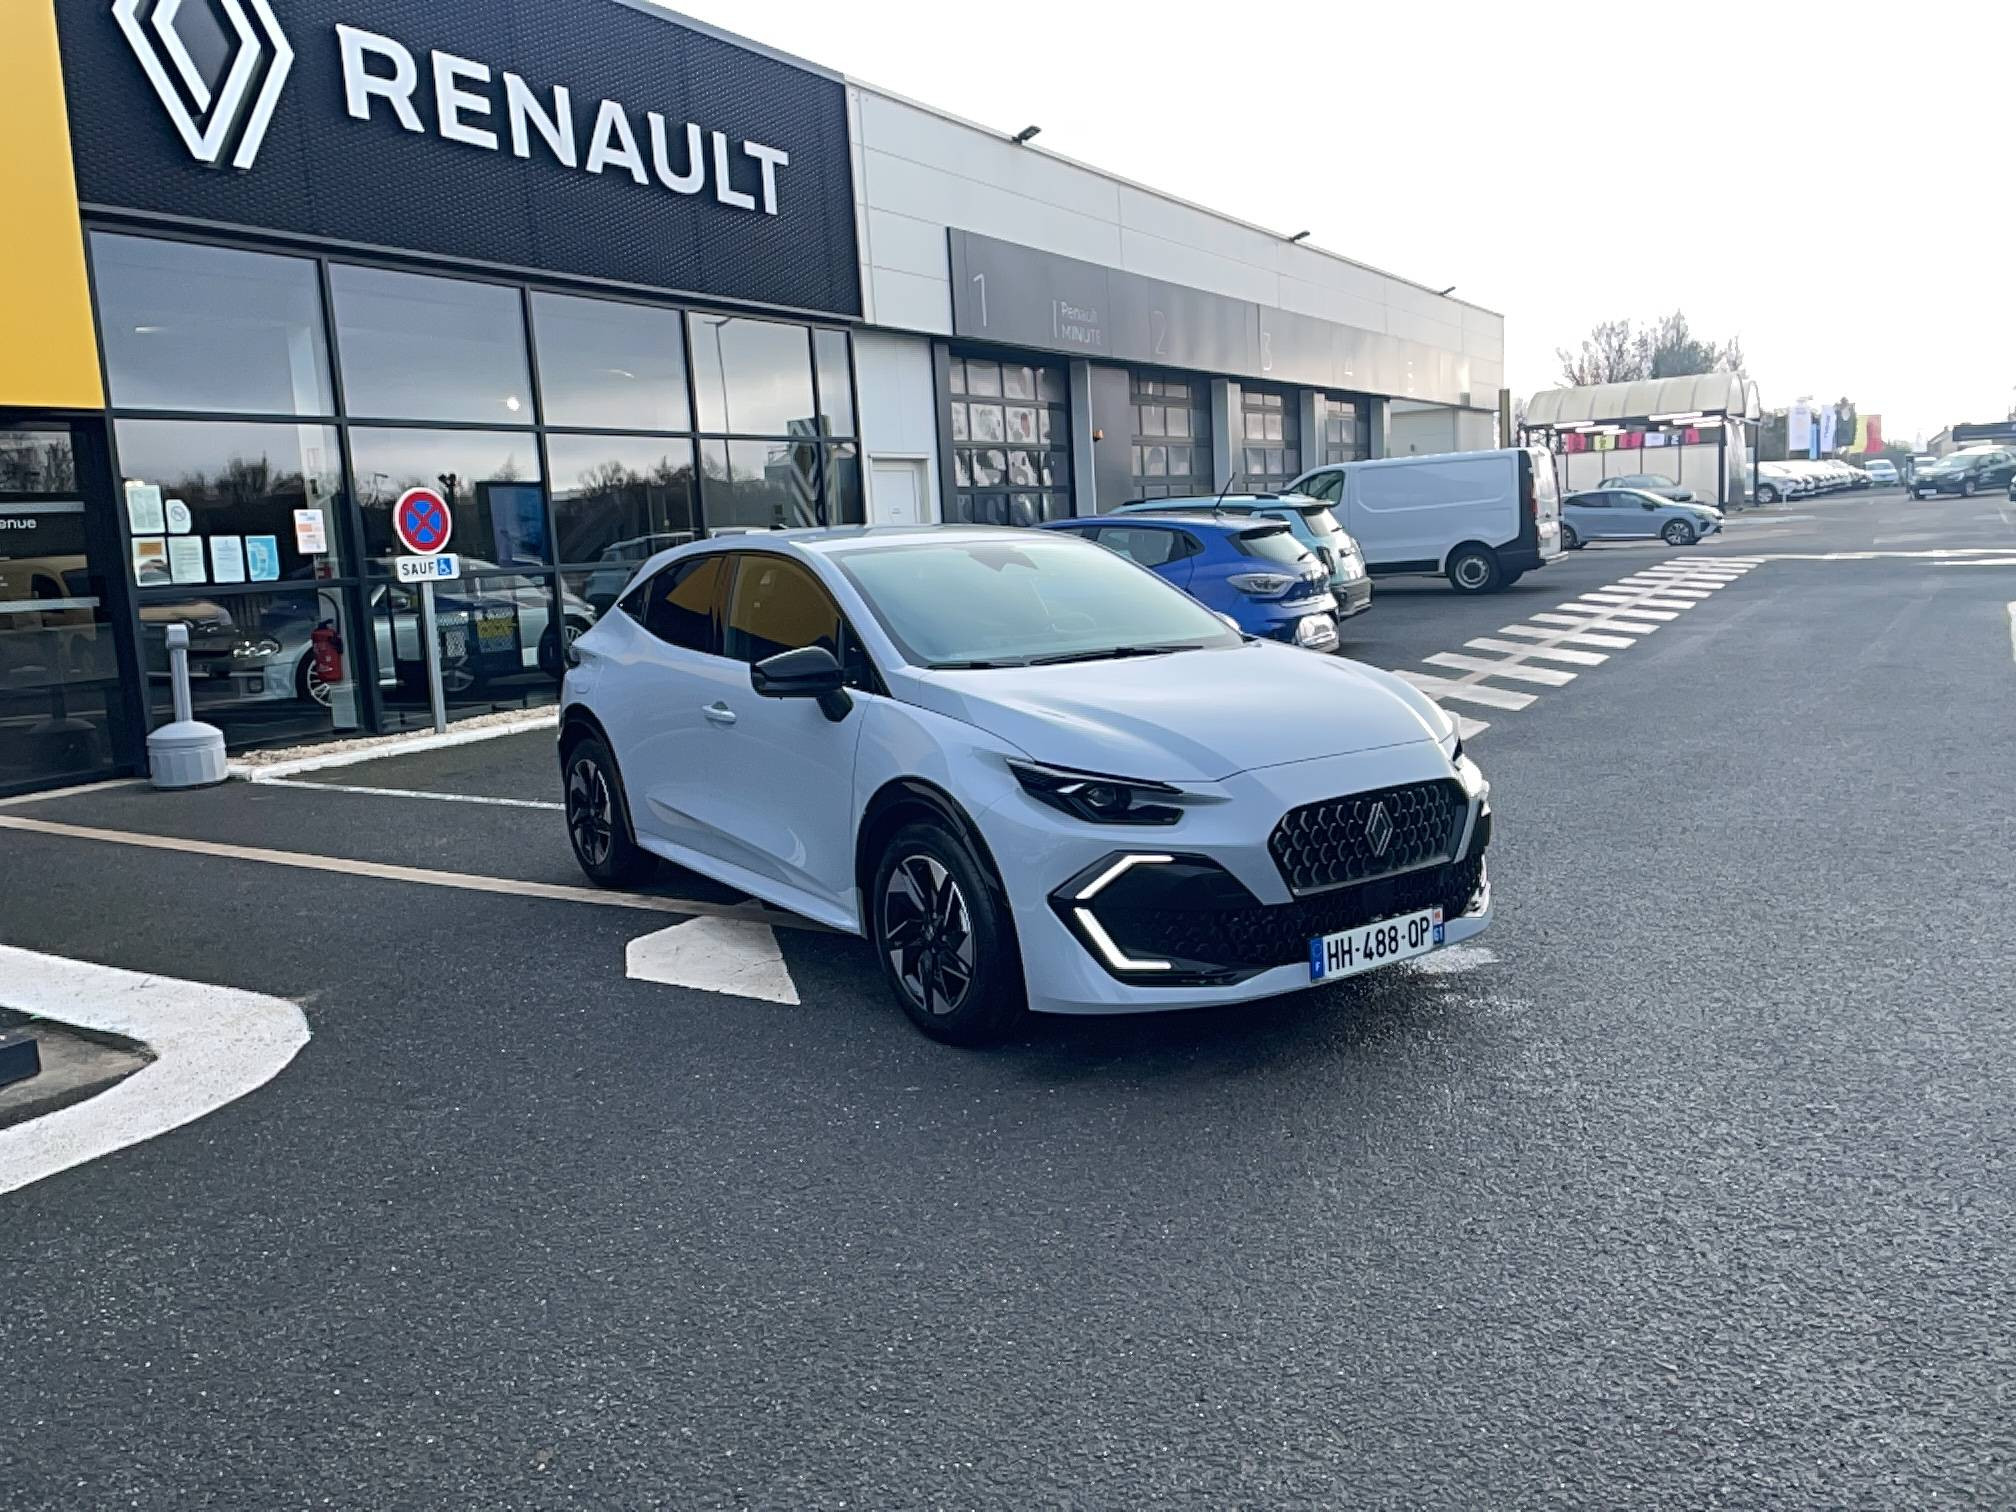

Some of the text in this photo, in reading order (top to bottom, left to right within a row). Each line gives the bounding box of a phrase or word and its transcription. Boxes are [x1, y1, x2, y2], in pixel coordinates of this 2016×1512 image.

[335, 23, 789, 216] RENAULT
[973, 273, 988, 328] 1
[1061, 324, 1102, 345] MINUTE
[1152, 309, 1168, 355] 2
[1263, 331, 1273, 371] 3
[402, 562, 435, 576] SAUF
[1315, 961, 1321, 972] F
